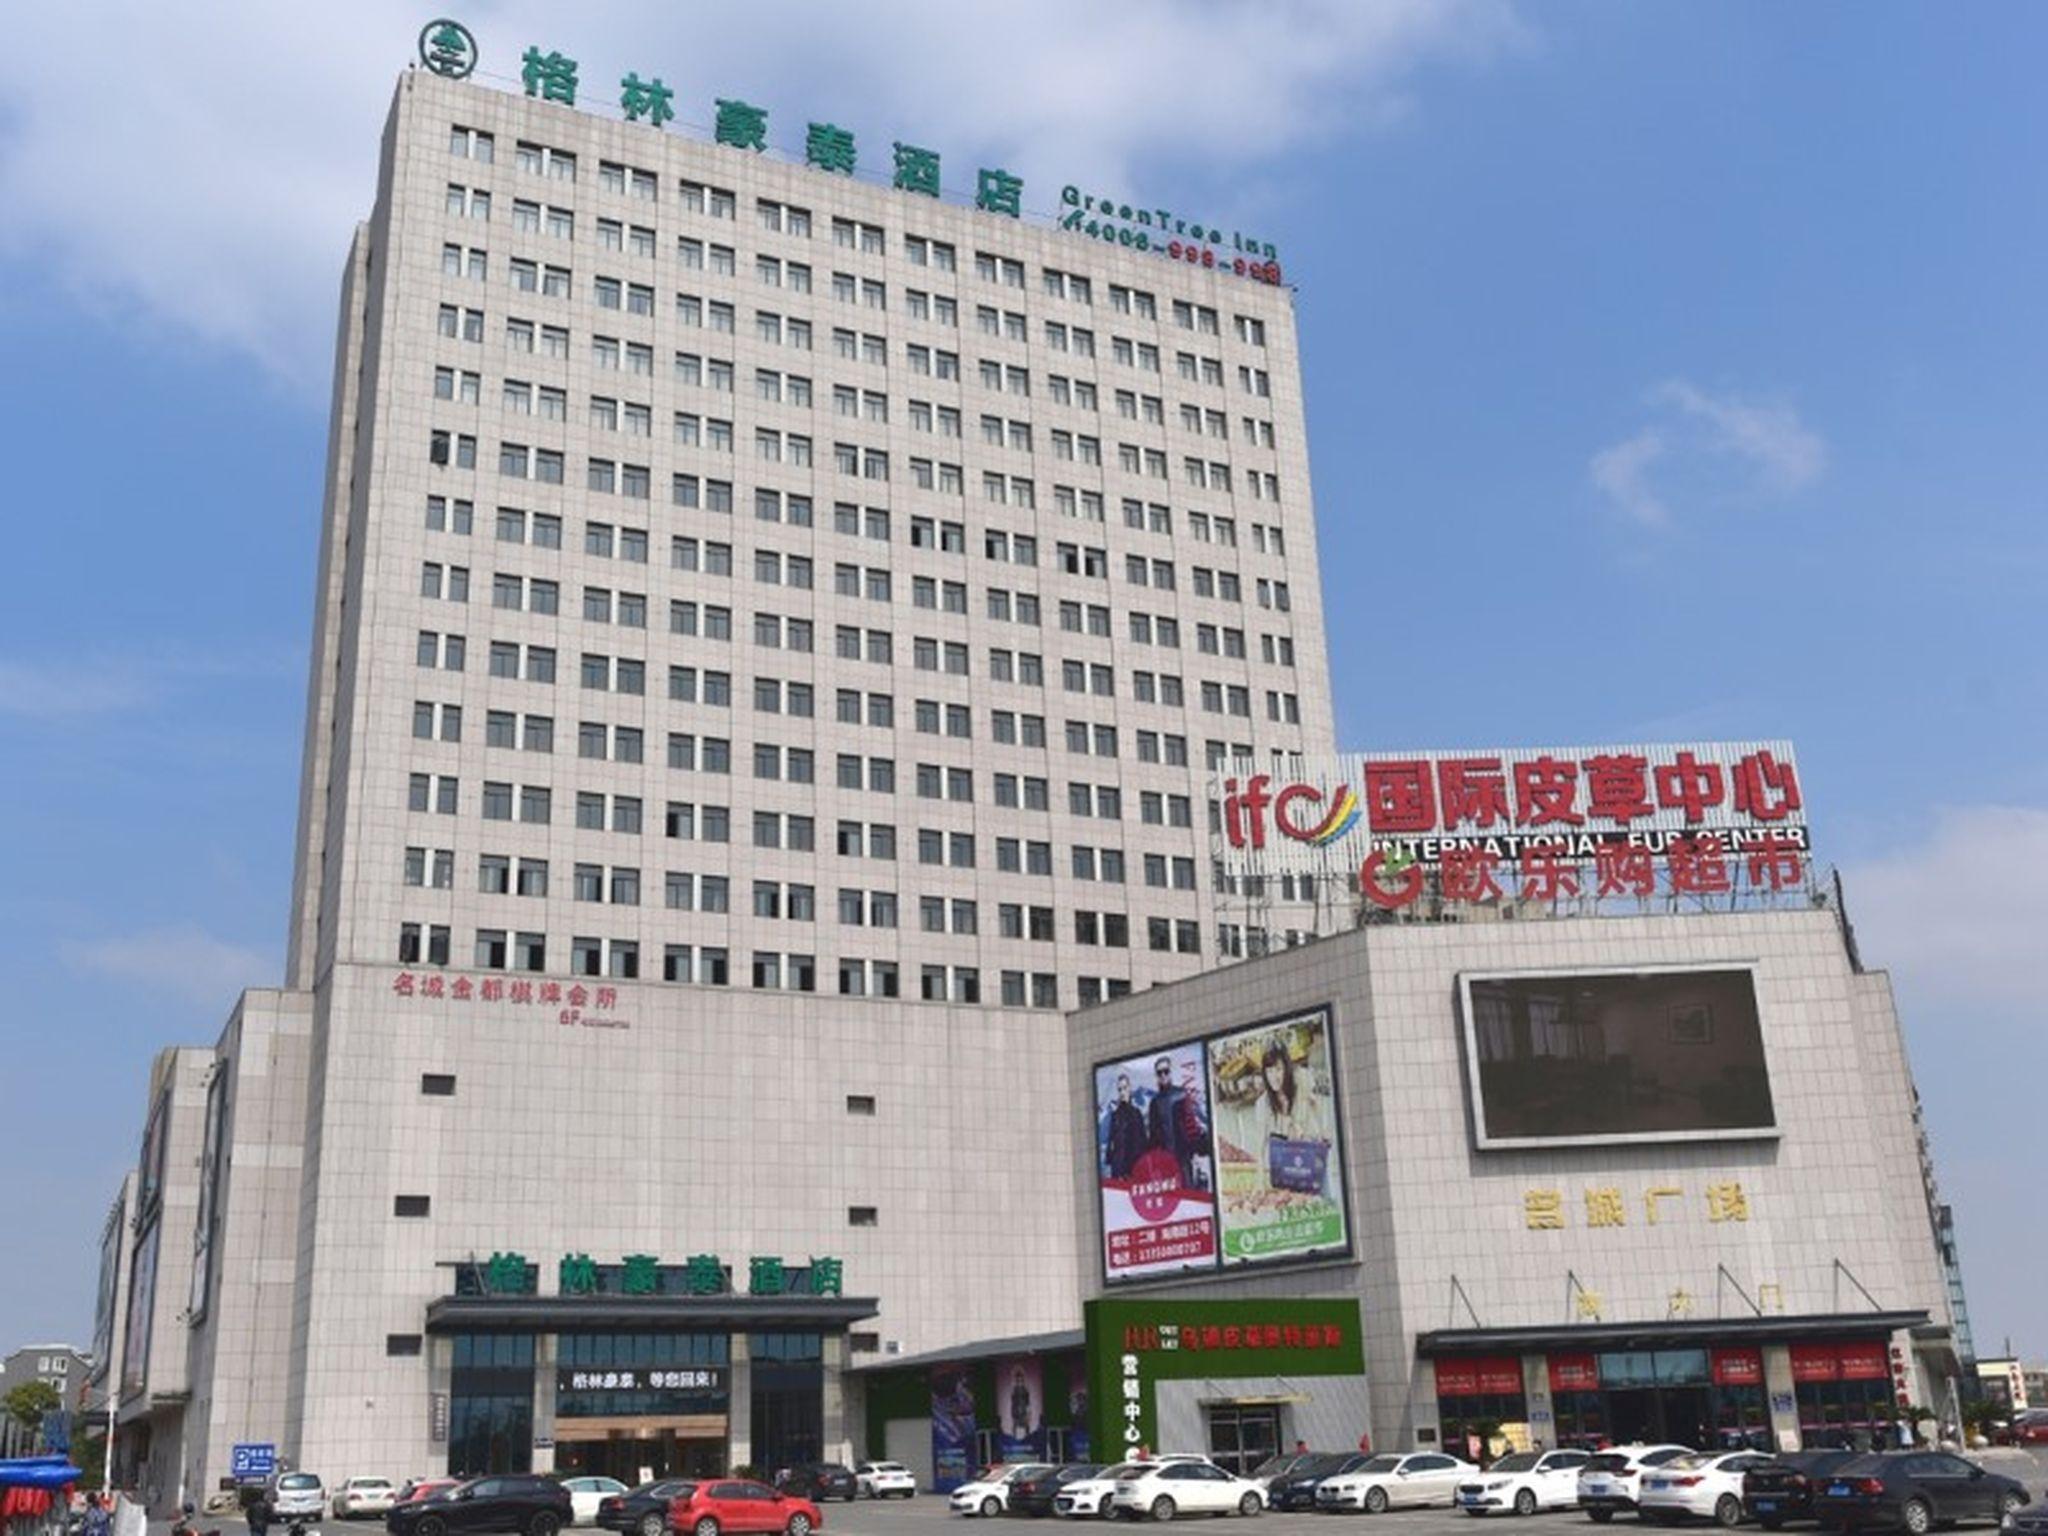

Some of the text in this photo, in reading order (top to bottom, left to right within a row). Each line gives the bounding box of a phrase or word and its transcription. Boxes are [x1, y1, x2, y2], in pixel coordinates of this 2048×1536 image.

[522, 45, 1024, 219] 格林豪泰酒店
[1062, 185, 1277, 260] GreenTree Inn
[1364, 749, 1802, 833] 国际皮草中心
[1442, 838, 1801, 901] 欧乐购超市
[489, 1251, 844, 1297] 格林豪泰酒店
